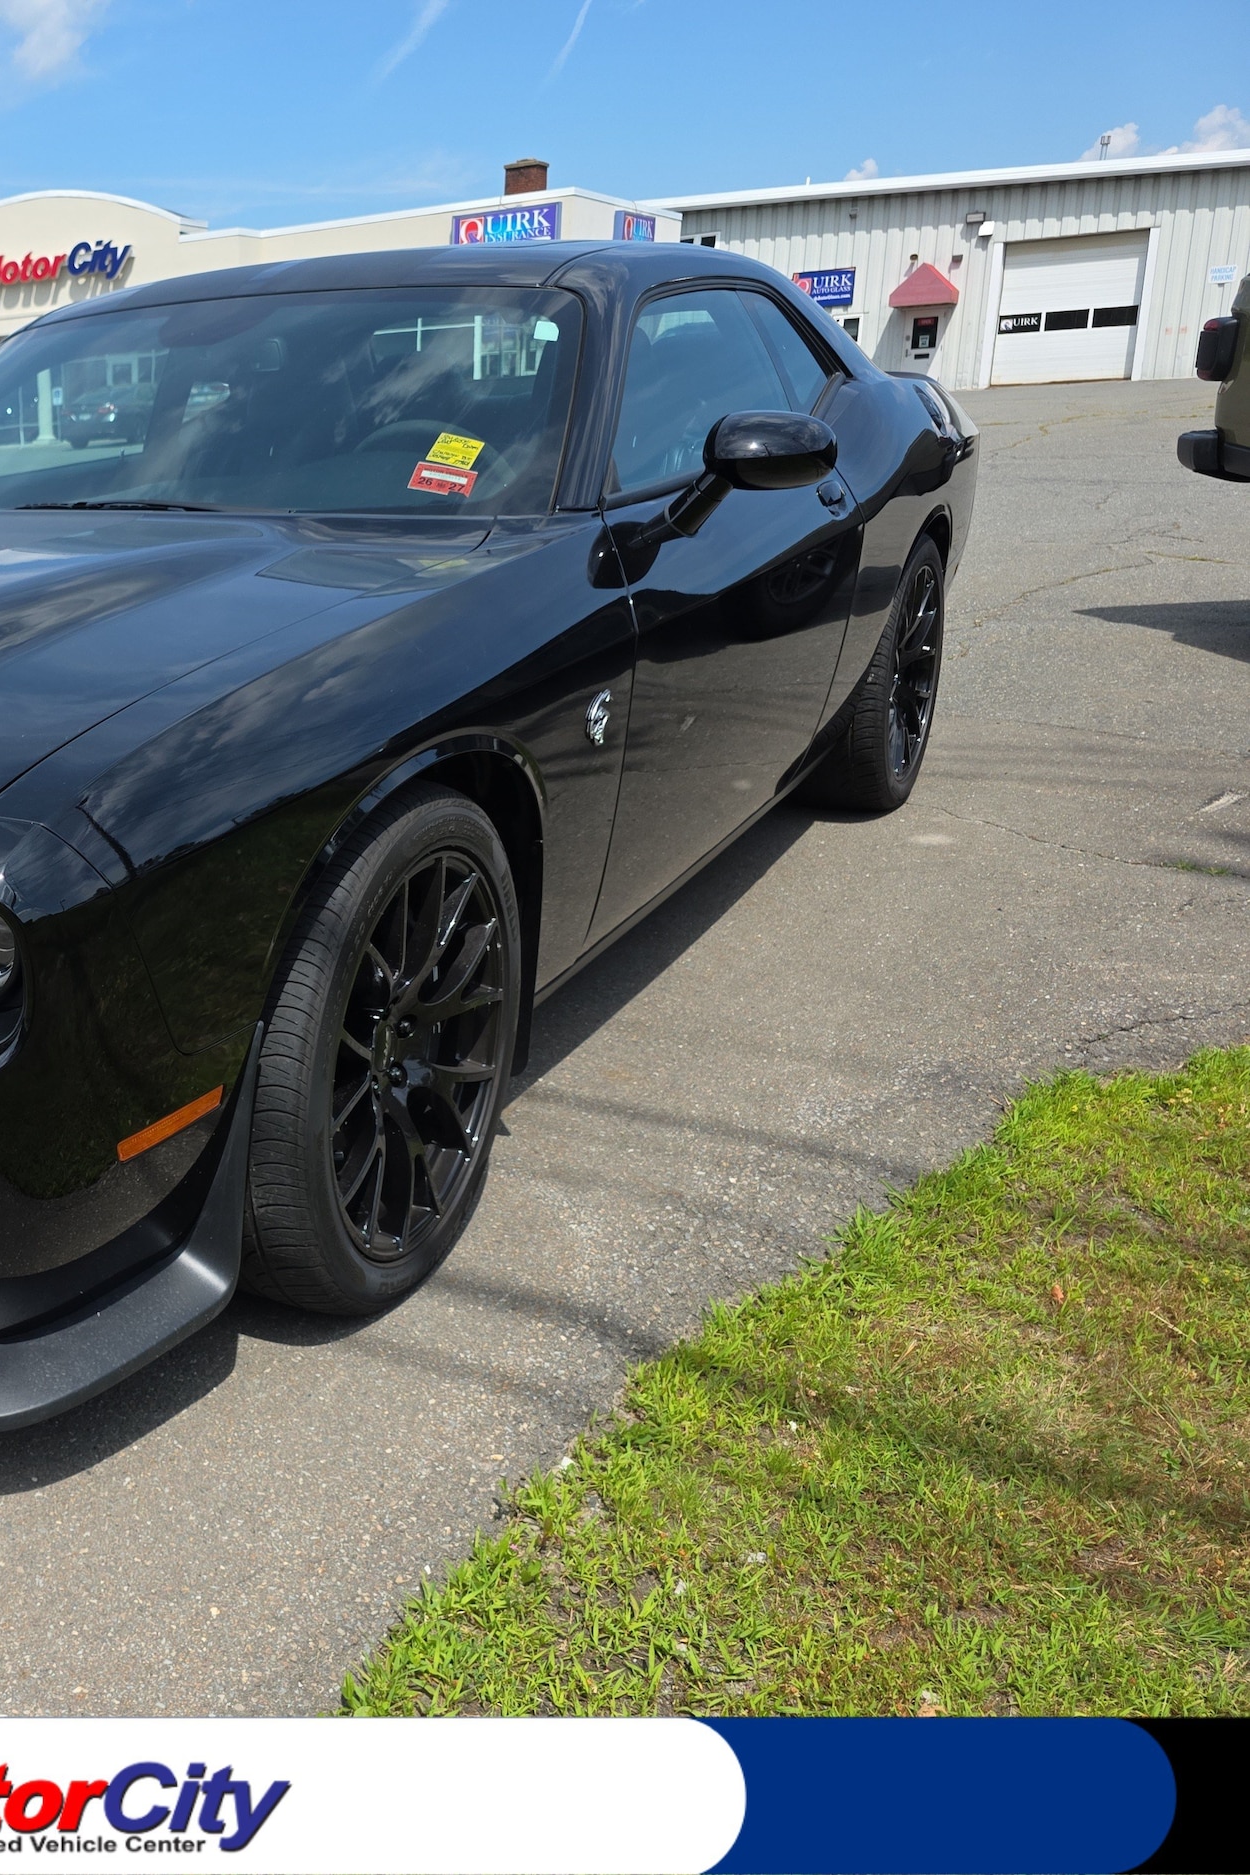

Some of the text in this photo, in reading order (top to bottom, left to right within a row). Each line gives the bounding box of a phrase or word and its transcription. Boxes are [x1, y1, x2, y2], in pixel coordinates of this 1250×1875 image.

[1210, 266, 1237, 274] HANDICAP
[1211, 274, 1234, 282] PARKING
[417, 477, 433, 486] 26
[448, 483, 466, 492] 27
